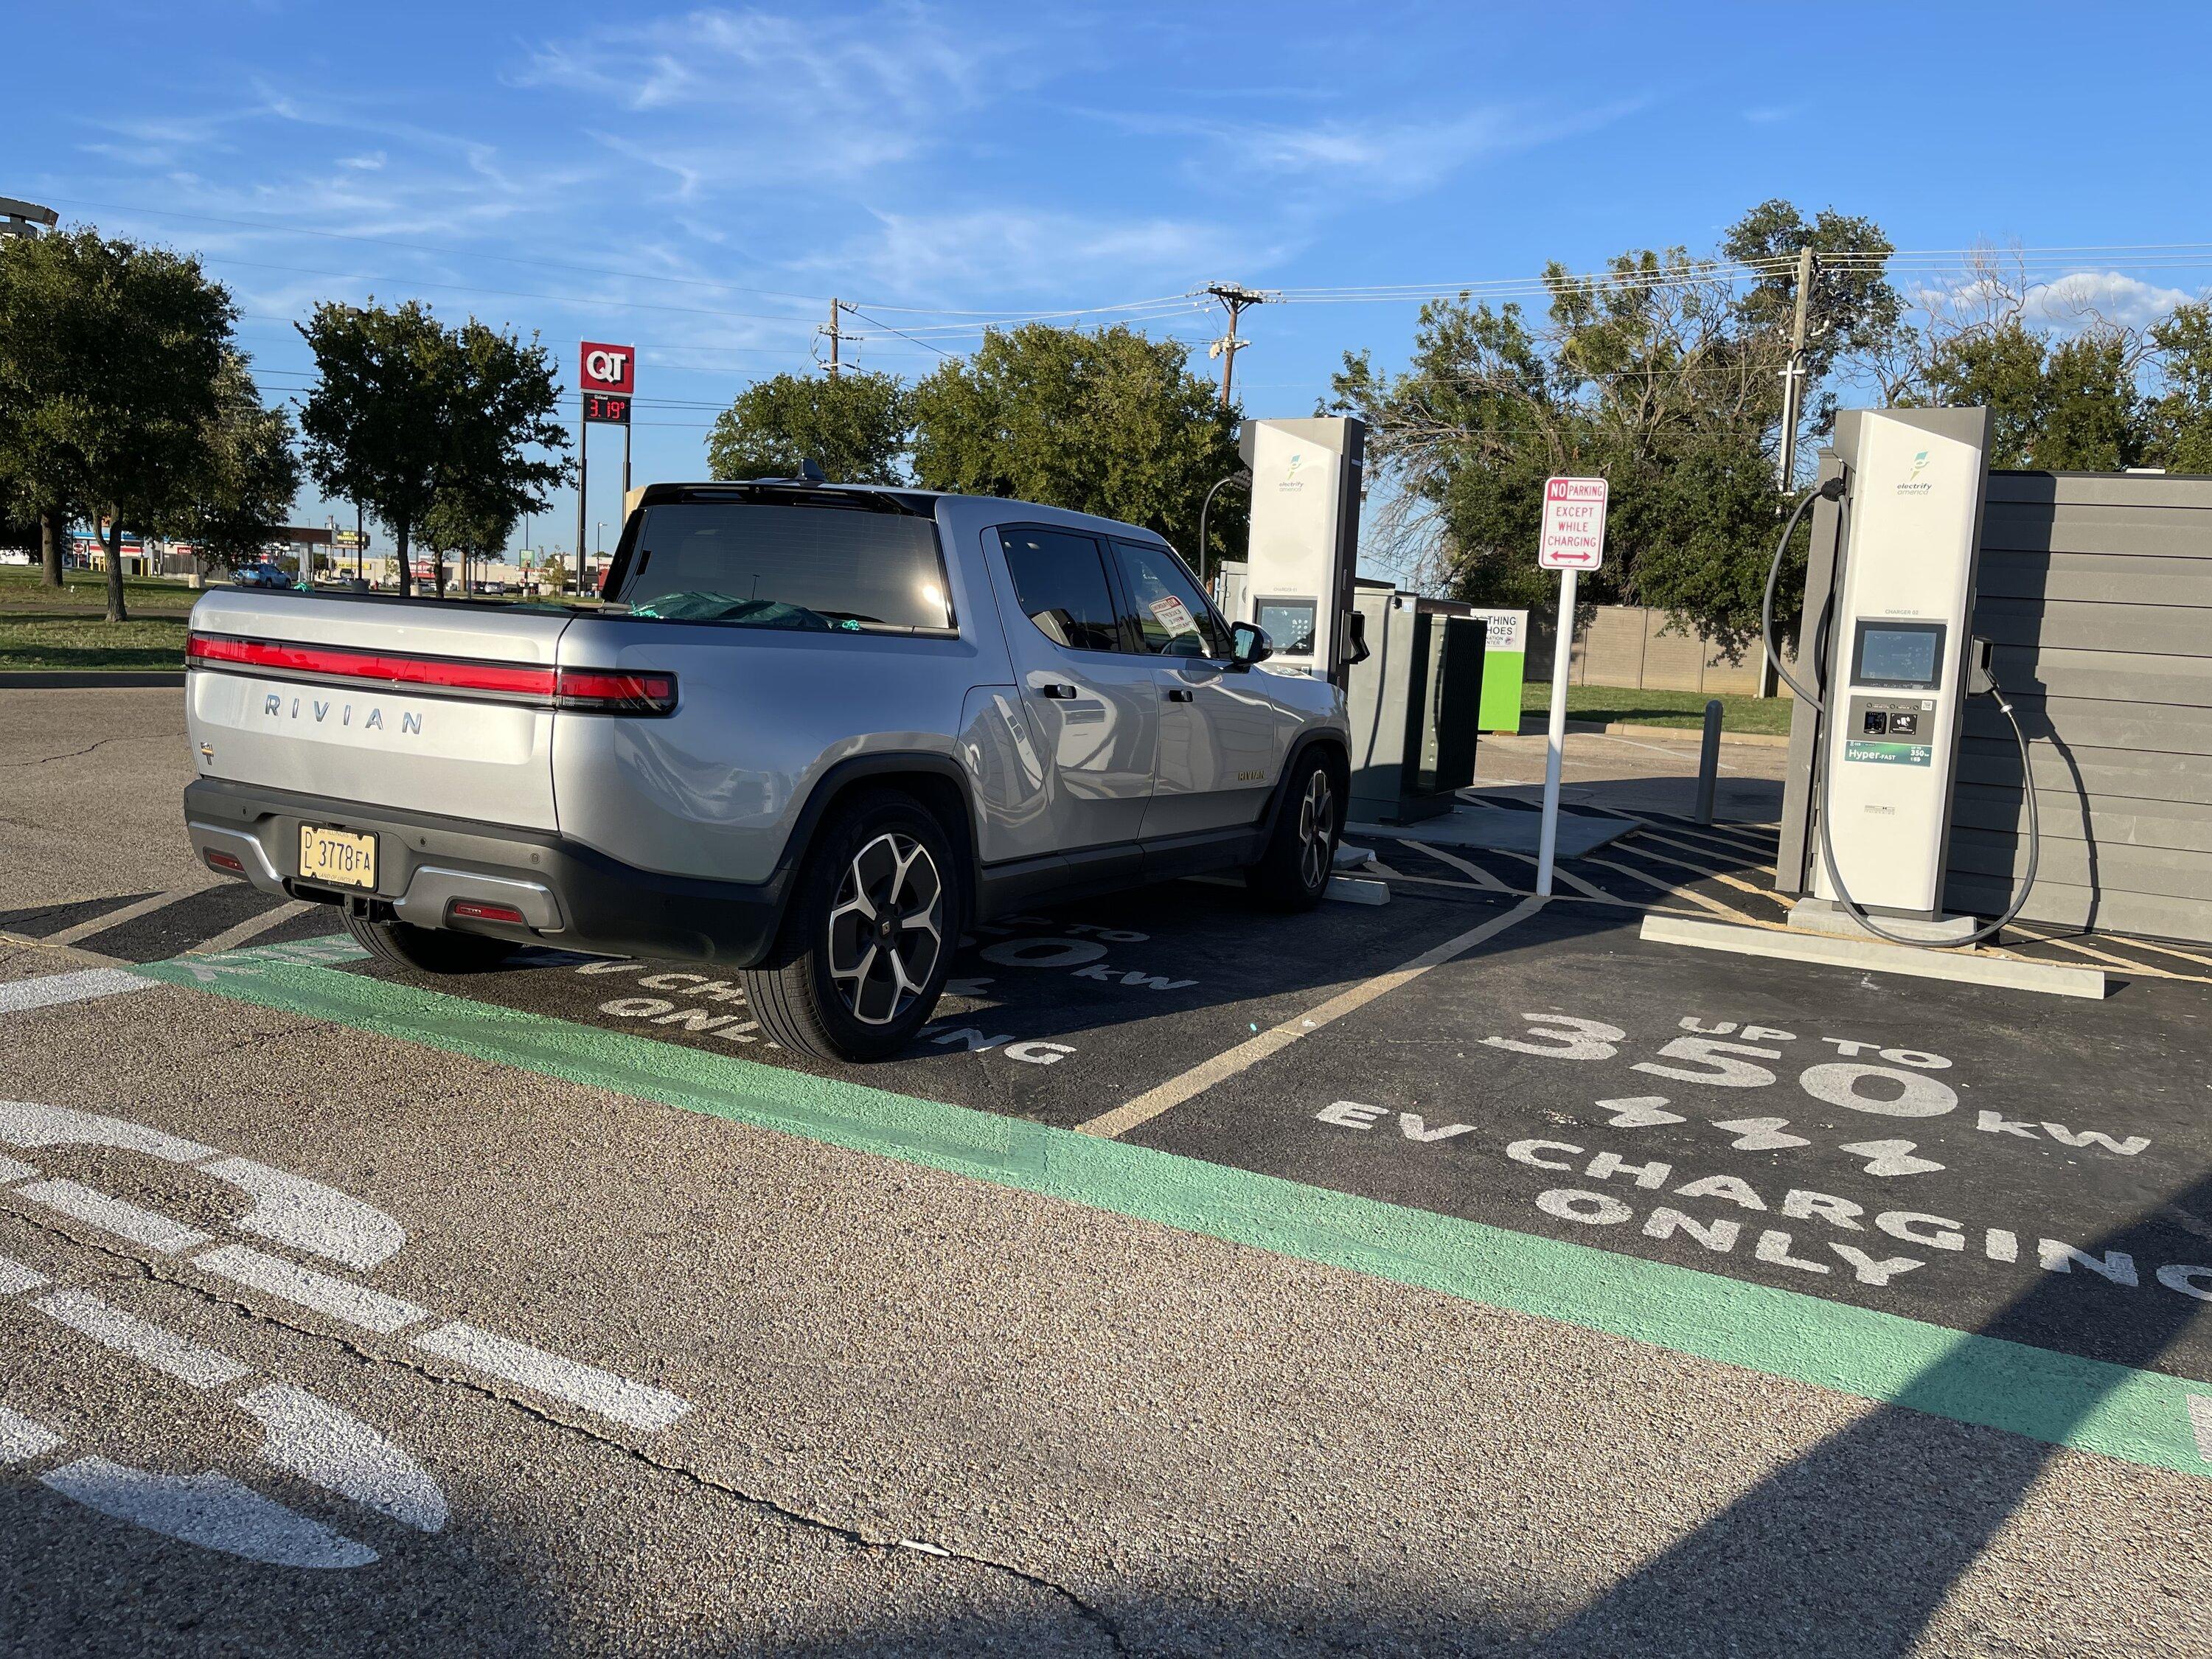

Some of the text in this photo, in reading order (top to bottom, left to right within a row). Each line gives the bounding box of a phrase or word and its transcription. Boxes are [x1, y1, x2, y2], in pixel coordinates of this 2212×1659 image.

[586, 350, 627, 383] QT
[1551, 483, 1602, 497] NO PARKING
[1557, 507, 1593, 517] EXCEPT
[1559, 521, 1588, 532] WHILE
[1548, 536, 1596, 547] CHARGING
[1486, 627, 1513, 636] HOES
[1487, 616, 1517, 626] THING
[265, 694, 422, 734] RIVIAN
[319, 841, 370, 872] 3778FA
[599, 998, 781, 1048] ONL
[1677, 1015, 1953, 1069] UP TO
[1478, 1012, 2152, 1157] 350 KW
[1315, 1099, 1476, 1143] EV
[1534, 1187, 1927, 1287] ONLY
